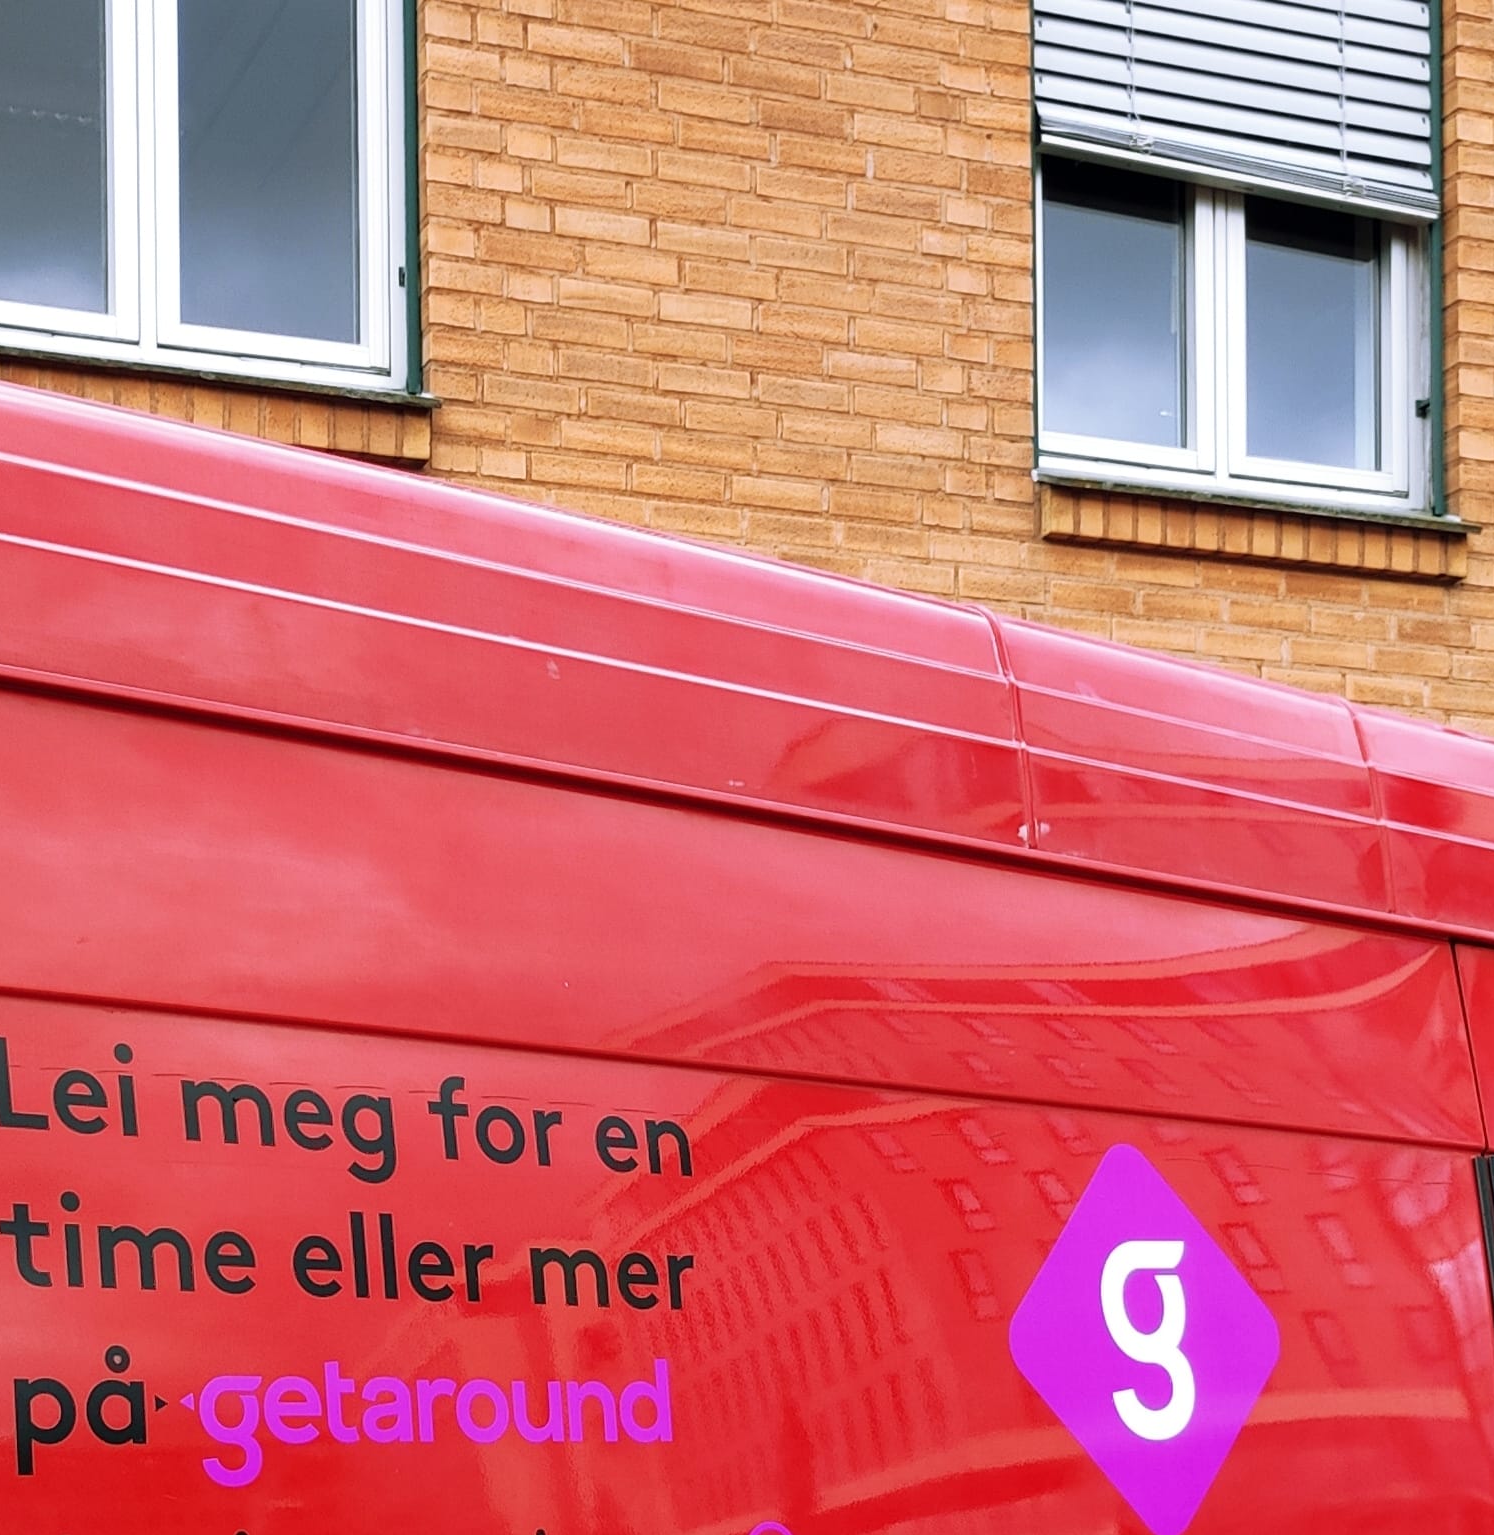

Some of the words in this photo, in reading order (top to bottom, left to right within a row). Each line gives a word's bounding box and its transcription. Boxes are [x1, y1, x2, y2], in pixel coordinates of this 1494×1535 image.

[181, 1080, 397, 1184] meg
[428, 1076, 562, 1166] for
[596, 1116, 693, 1177] en
[293, 1211, 494, 1302] eller
[530, 1247, 694, 1310] mer
[13, 1345, 147, 1476] på
[198, 1358, 673, 1488] getaround
